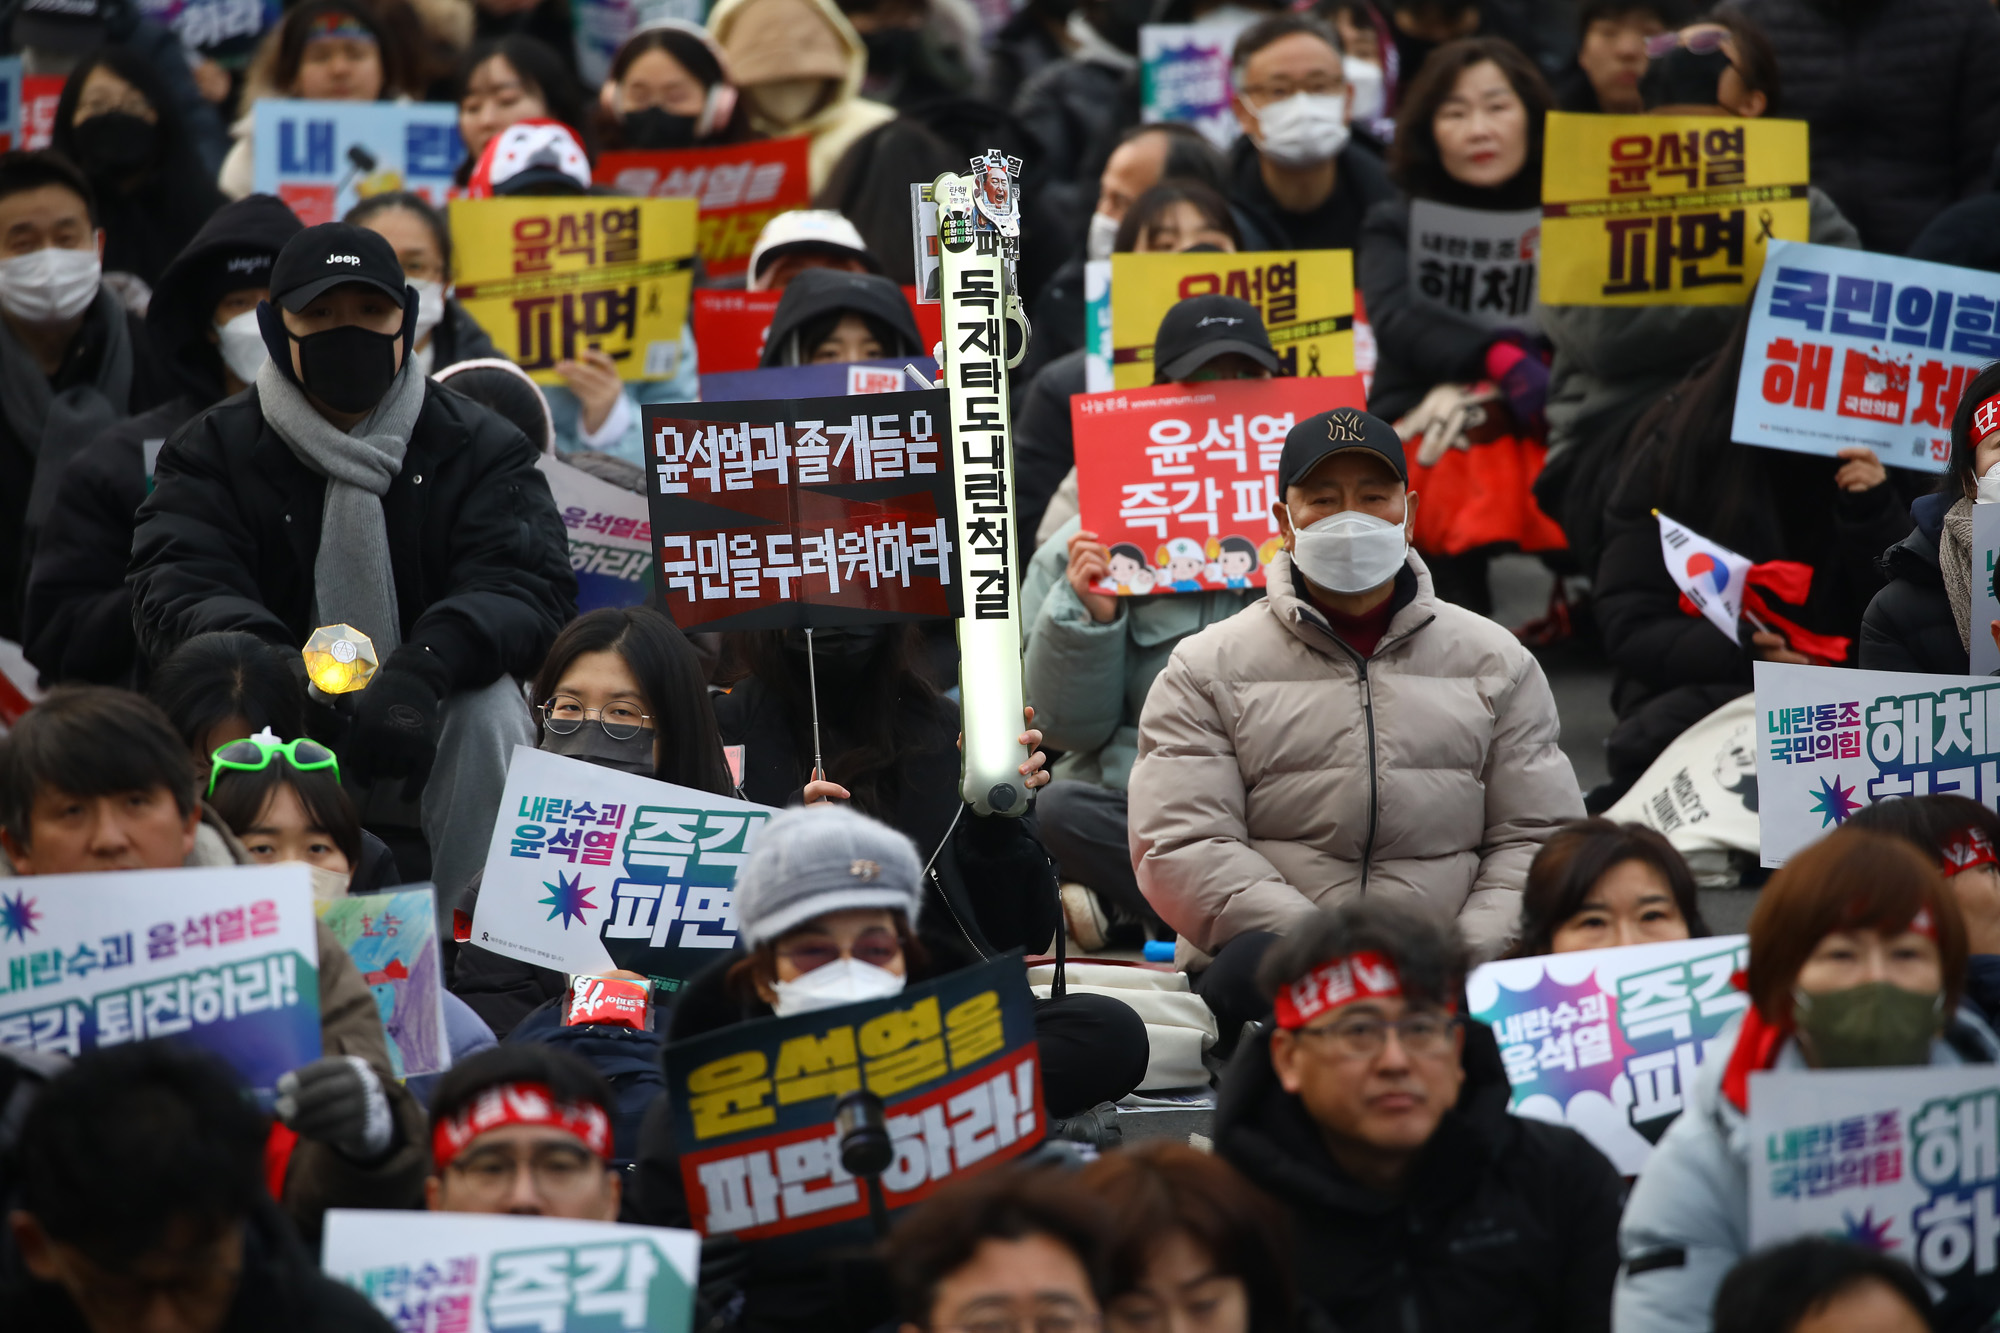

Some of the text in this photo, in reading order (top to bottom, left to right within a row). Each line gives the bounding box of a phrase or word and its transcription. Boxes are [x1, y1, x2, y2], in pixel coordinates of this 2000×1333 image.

[948, 186, 967, 197] 탄핵
[1608, 126, 1746, 195] 윤석열
[326, 253, 360, 266] Jeep
[512, 204, 640, 275] 윤석열
[1602, 208, 1746, 297] 파면
[1419, 257, 1535, 318] 해체
[1768, 265, 2000, 358] 국민의힘
[511, 285, 639, 372] 파면
[1844, 394, 1900, 419] 국민의힘
[1145, 412, 1296, 477] 윤석열
[1119, 474, 1223, 540] 즉각
[1768, 701, 1861, 735] 내란동조
[1770, 730, 1861, 765] 국민의힘
[1869, 688, 2000, 766] 해체
[518, 795, 627, 830] 내란수괴
[510, 824, 618, 867] 윤석열
[626, 810, 766, 882] 즉각
[604, 882, 739, 950] 파면
[95, 953, 299, 1048] 퇴진하라!
[1492, 992, 1609, 1046] 내란수괴
[687, 989, 1005, 1141] 윤석열을
[1500, 1021, 1614, 1086] 윤석열
[1627, 1034, 1718, 1125] 파
[1766, 1107, 1903, 1163] 내란동조
[1770, 1148, 1904, 1202] 국민의힘
[488, 1241, 659, 1333] 즉각
